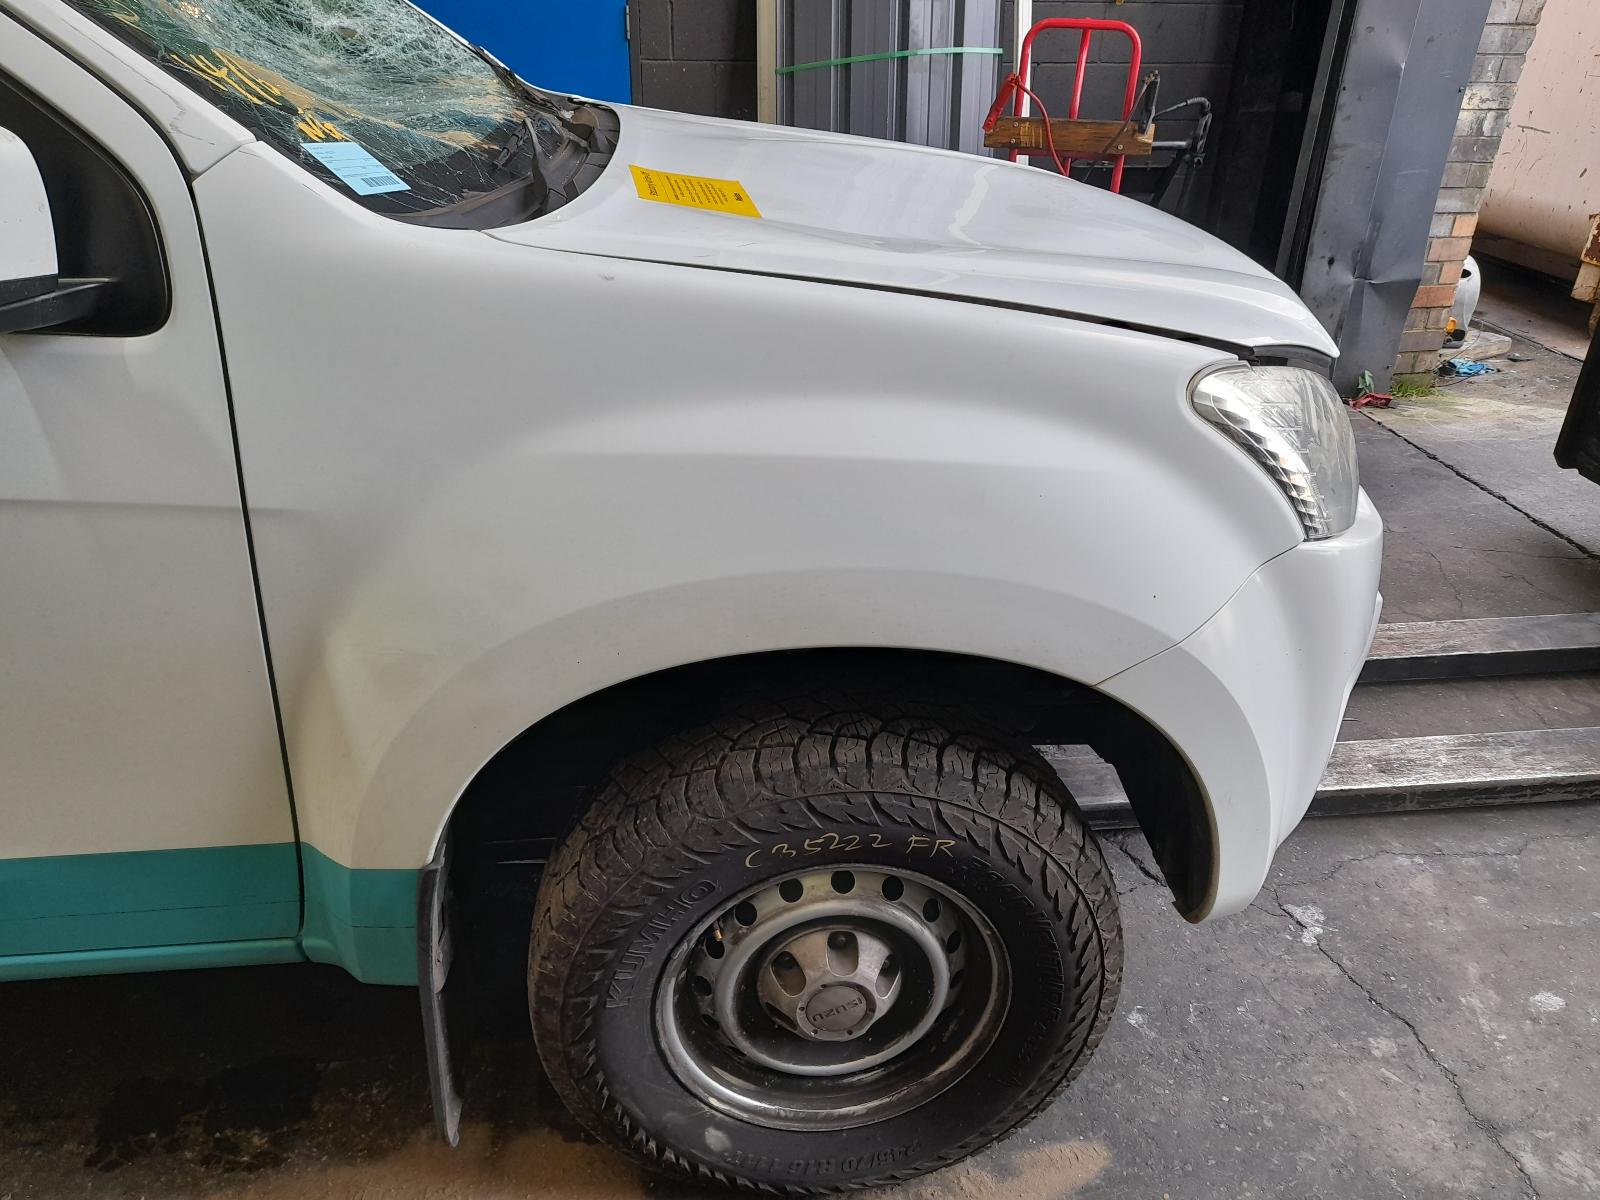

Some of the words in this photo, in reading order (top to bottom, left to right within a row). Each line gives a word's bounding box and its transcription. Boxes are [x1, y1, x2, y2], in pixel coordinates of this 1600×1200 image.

[905, 833, 957, 858] FR
[606, 879, 718, 1008] KUMHO
[811, 997, 863, 1022] ISUZU
